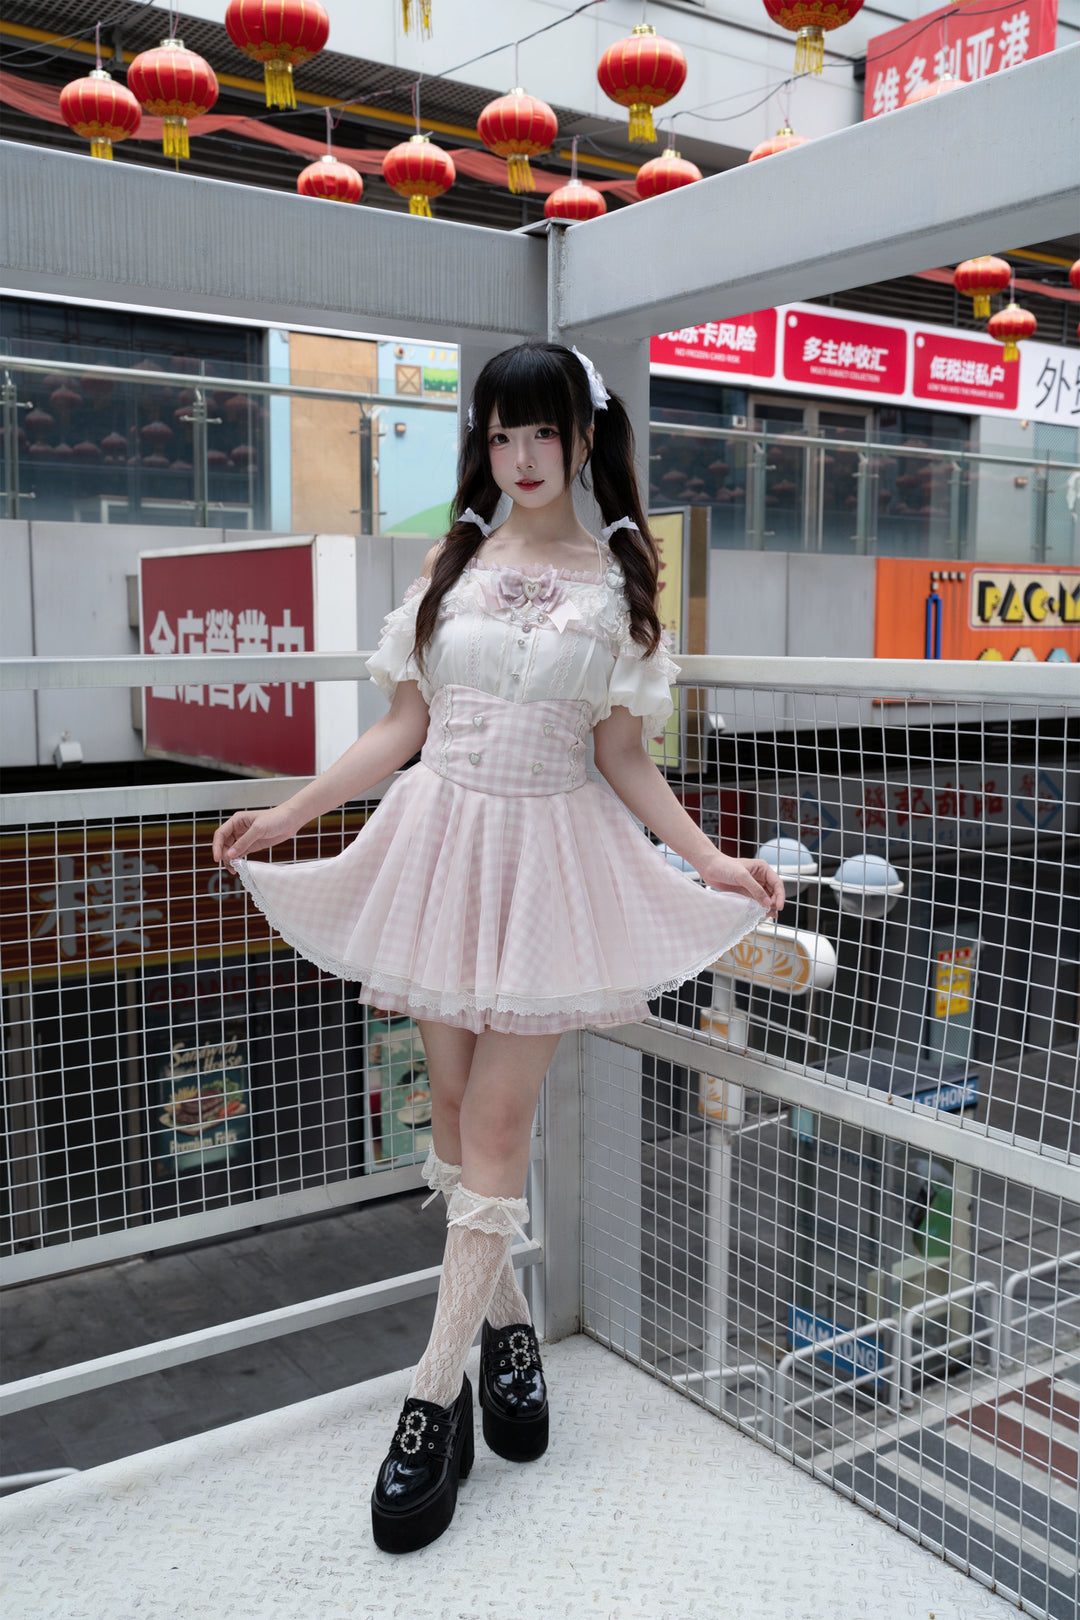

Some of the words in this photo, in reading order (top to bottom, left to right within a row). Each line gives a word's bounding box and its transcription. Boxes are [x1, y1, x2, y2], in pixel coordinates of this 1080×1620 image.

[872, 10, 1030, 114] 维多利亚港
[802, 336, 889, 372] 多主体收汇
[930, 355, 1005, 387] 低税进私户
[1035, 357, 1080, 414] 外
[34, 849, 164, 957] 樓
